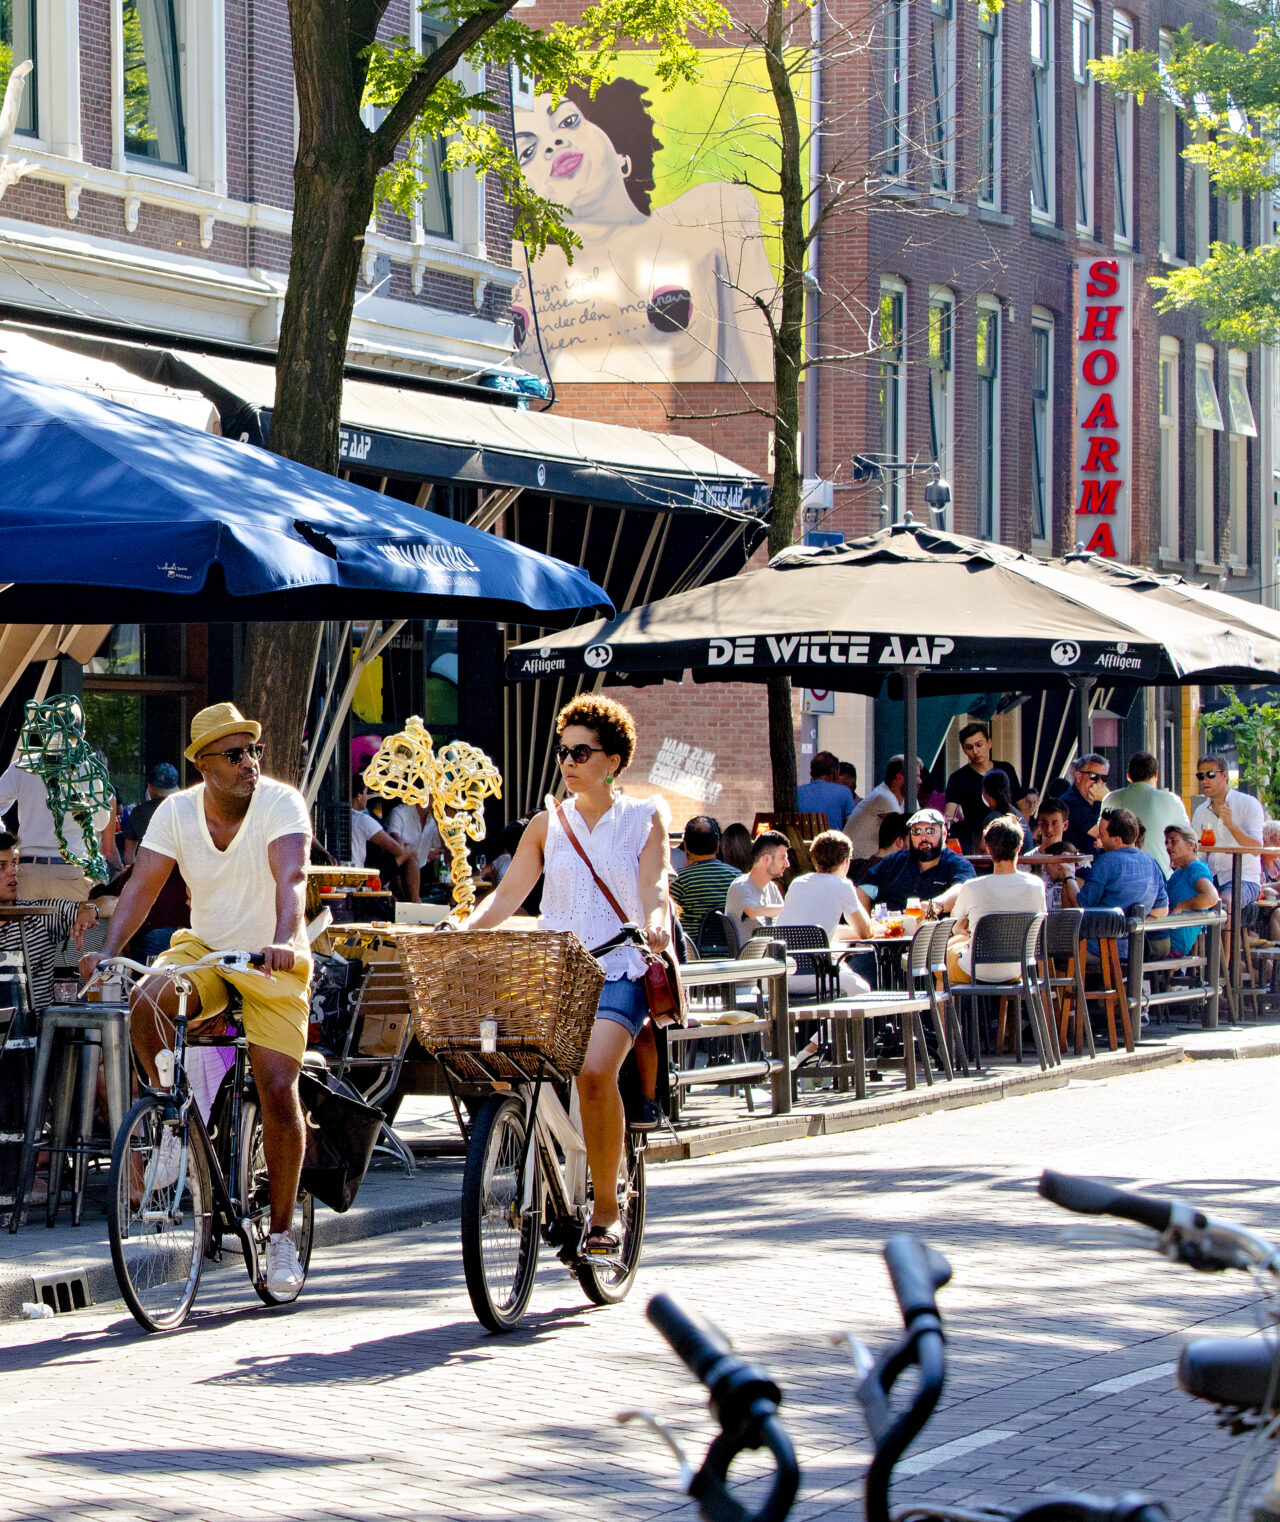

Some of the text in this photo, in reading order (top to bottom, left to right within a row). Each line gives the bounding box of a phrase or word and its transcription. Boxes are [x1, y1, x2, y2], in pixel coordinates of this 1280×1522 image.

[1075, 260, 1124, 558] SHOARMA
[693, 484, 705, 505] DE
[708, 635, 955, 666] DE WITTE AAP
[520, 658, 566, 675] Affligem
[1094, 653, 1142, 670] Affligem
